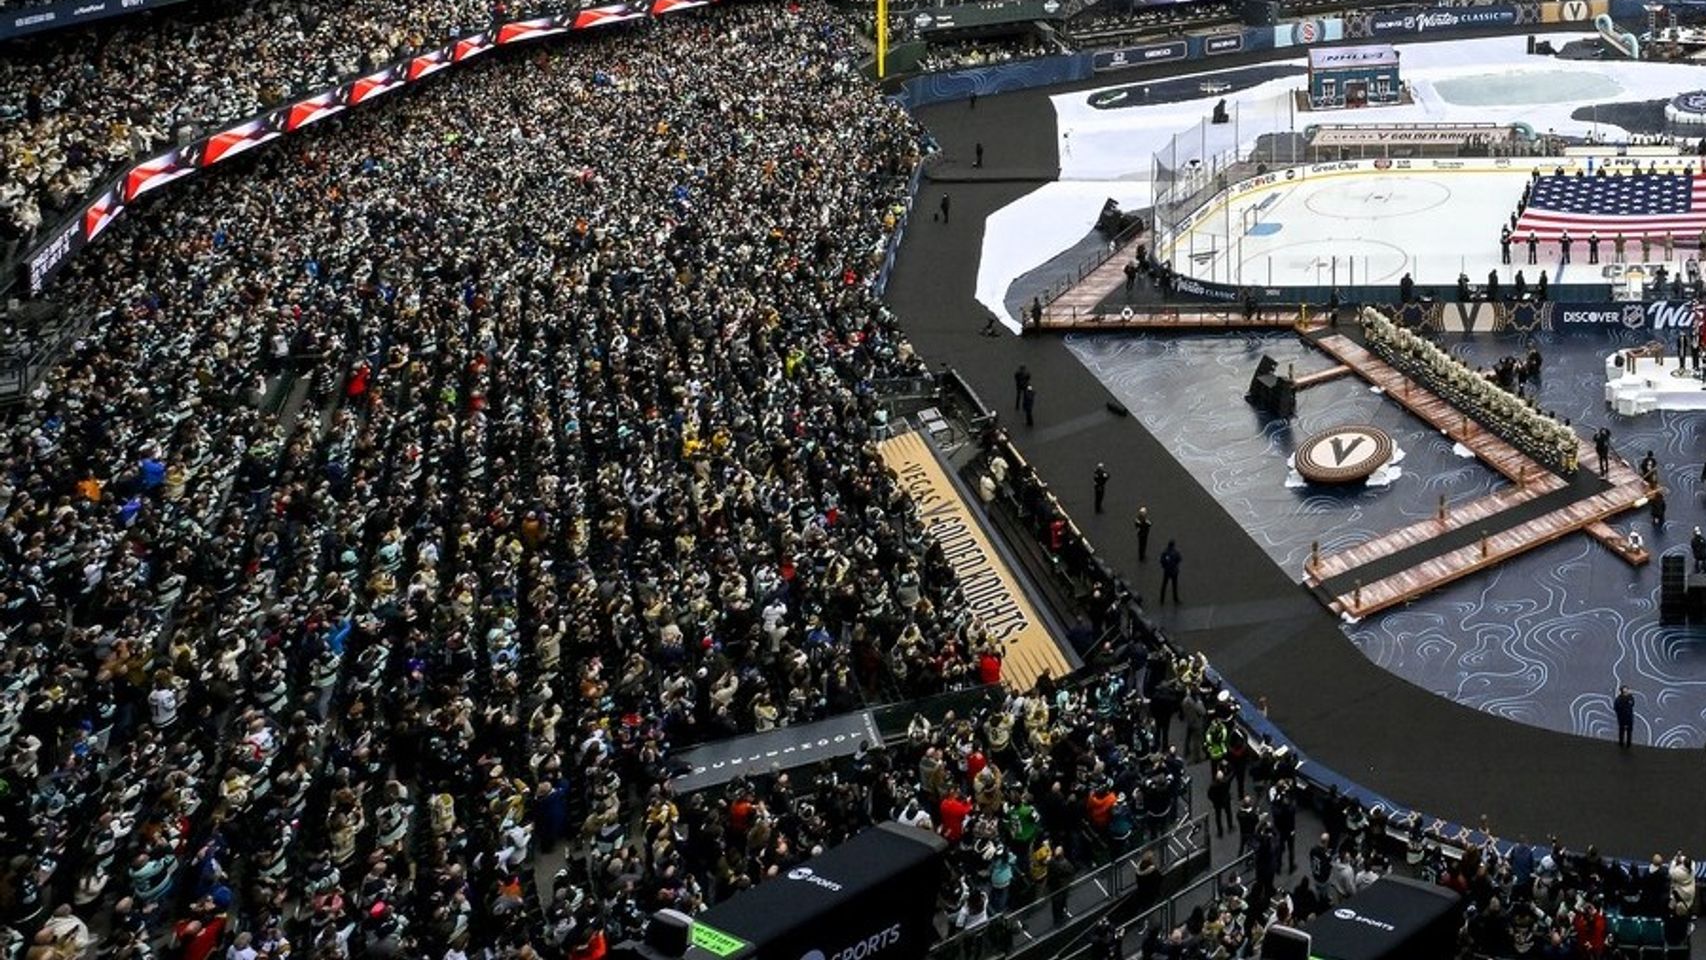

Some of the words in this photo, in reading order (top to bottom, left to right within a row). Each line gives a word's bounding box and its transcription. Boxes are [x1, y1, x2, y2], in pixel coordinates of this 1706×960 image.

[1415, 13, 1459, 32] Winter
[1460, 12, 1500, 23] CLASSIC
[1311, 164, 1337, 173] Great
[1338, 162, 1359, 171] Clips
[1615, 158, 1641, 166] PEPSI
[1239, 174, 1277, 192] DISCOVER
[1563, 311, 1619, 323] DISCOVER
[1329, 436, 1366, 466] V
[901, 462, 942, 505] VEGAS
[960, 565, 1029, 641] KNIGHTS
[1356, 915, 1395, 931] SPORTS
